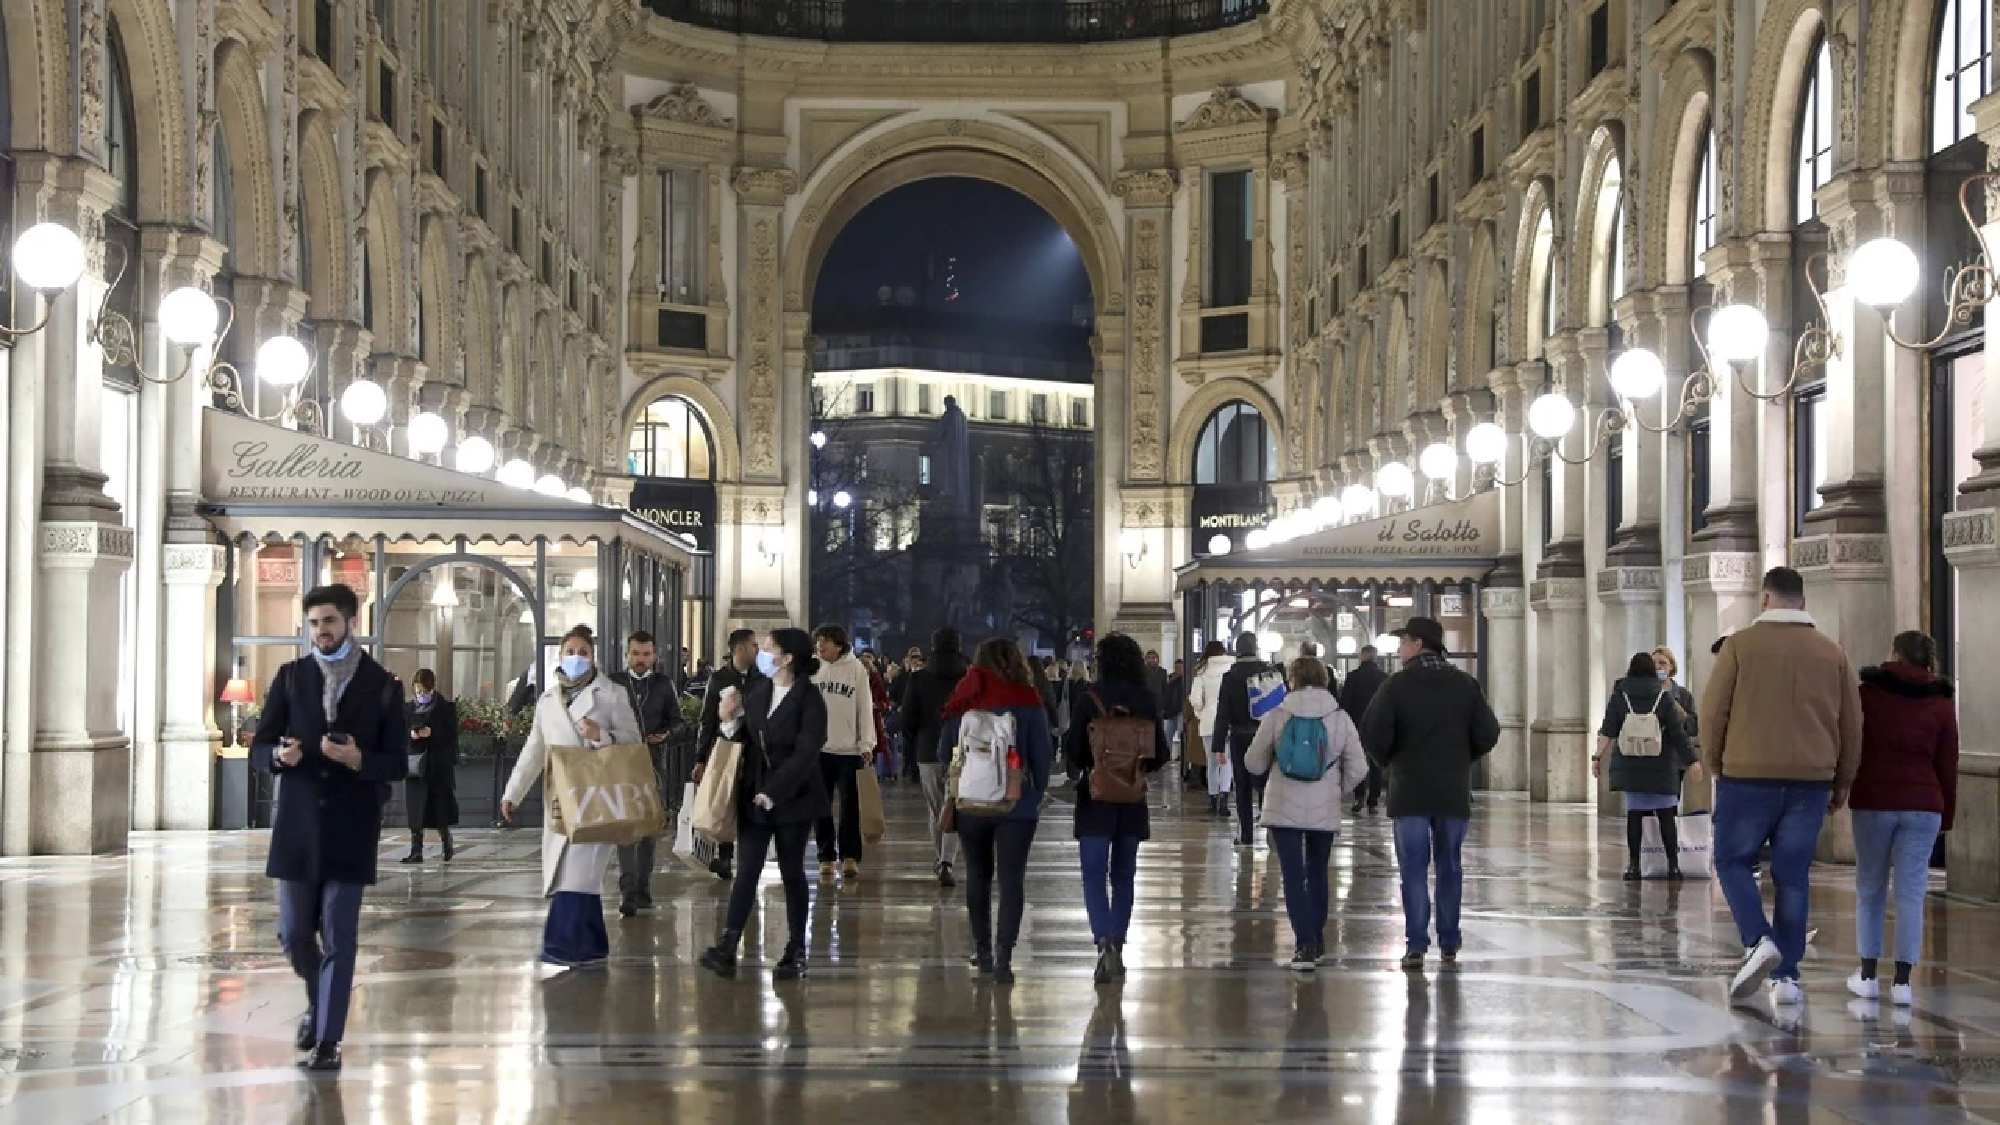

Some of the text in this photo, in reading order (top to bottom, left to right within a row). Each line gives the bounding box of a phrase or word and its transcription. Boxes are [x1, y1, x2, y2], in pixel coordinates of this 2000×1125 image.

[227, 440, 363, 479] Galleria
[227, 486, 333, 500] RESTAURANT
[344, 488, 394, 501] WOOD
[394, 489, 438, 503] OVEN
[440, 489, 486, 503] PIZZA
[636, 508, 703, 527] MONCLER
[1199, 512, 1268, 529] MONTBLANC
[1377, 519, 1481, 542] il Salotto
